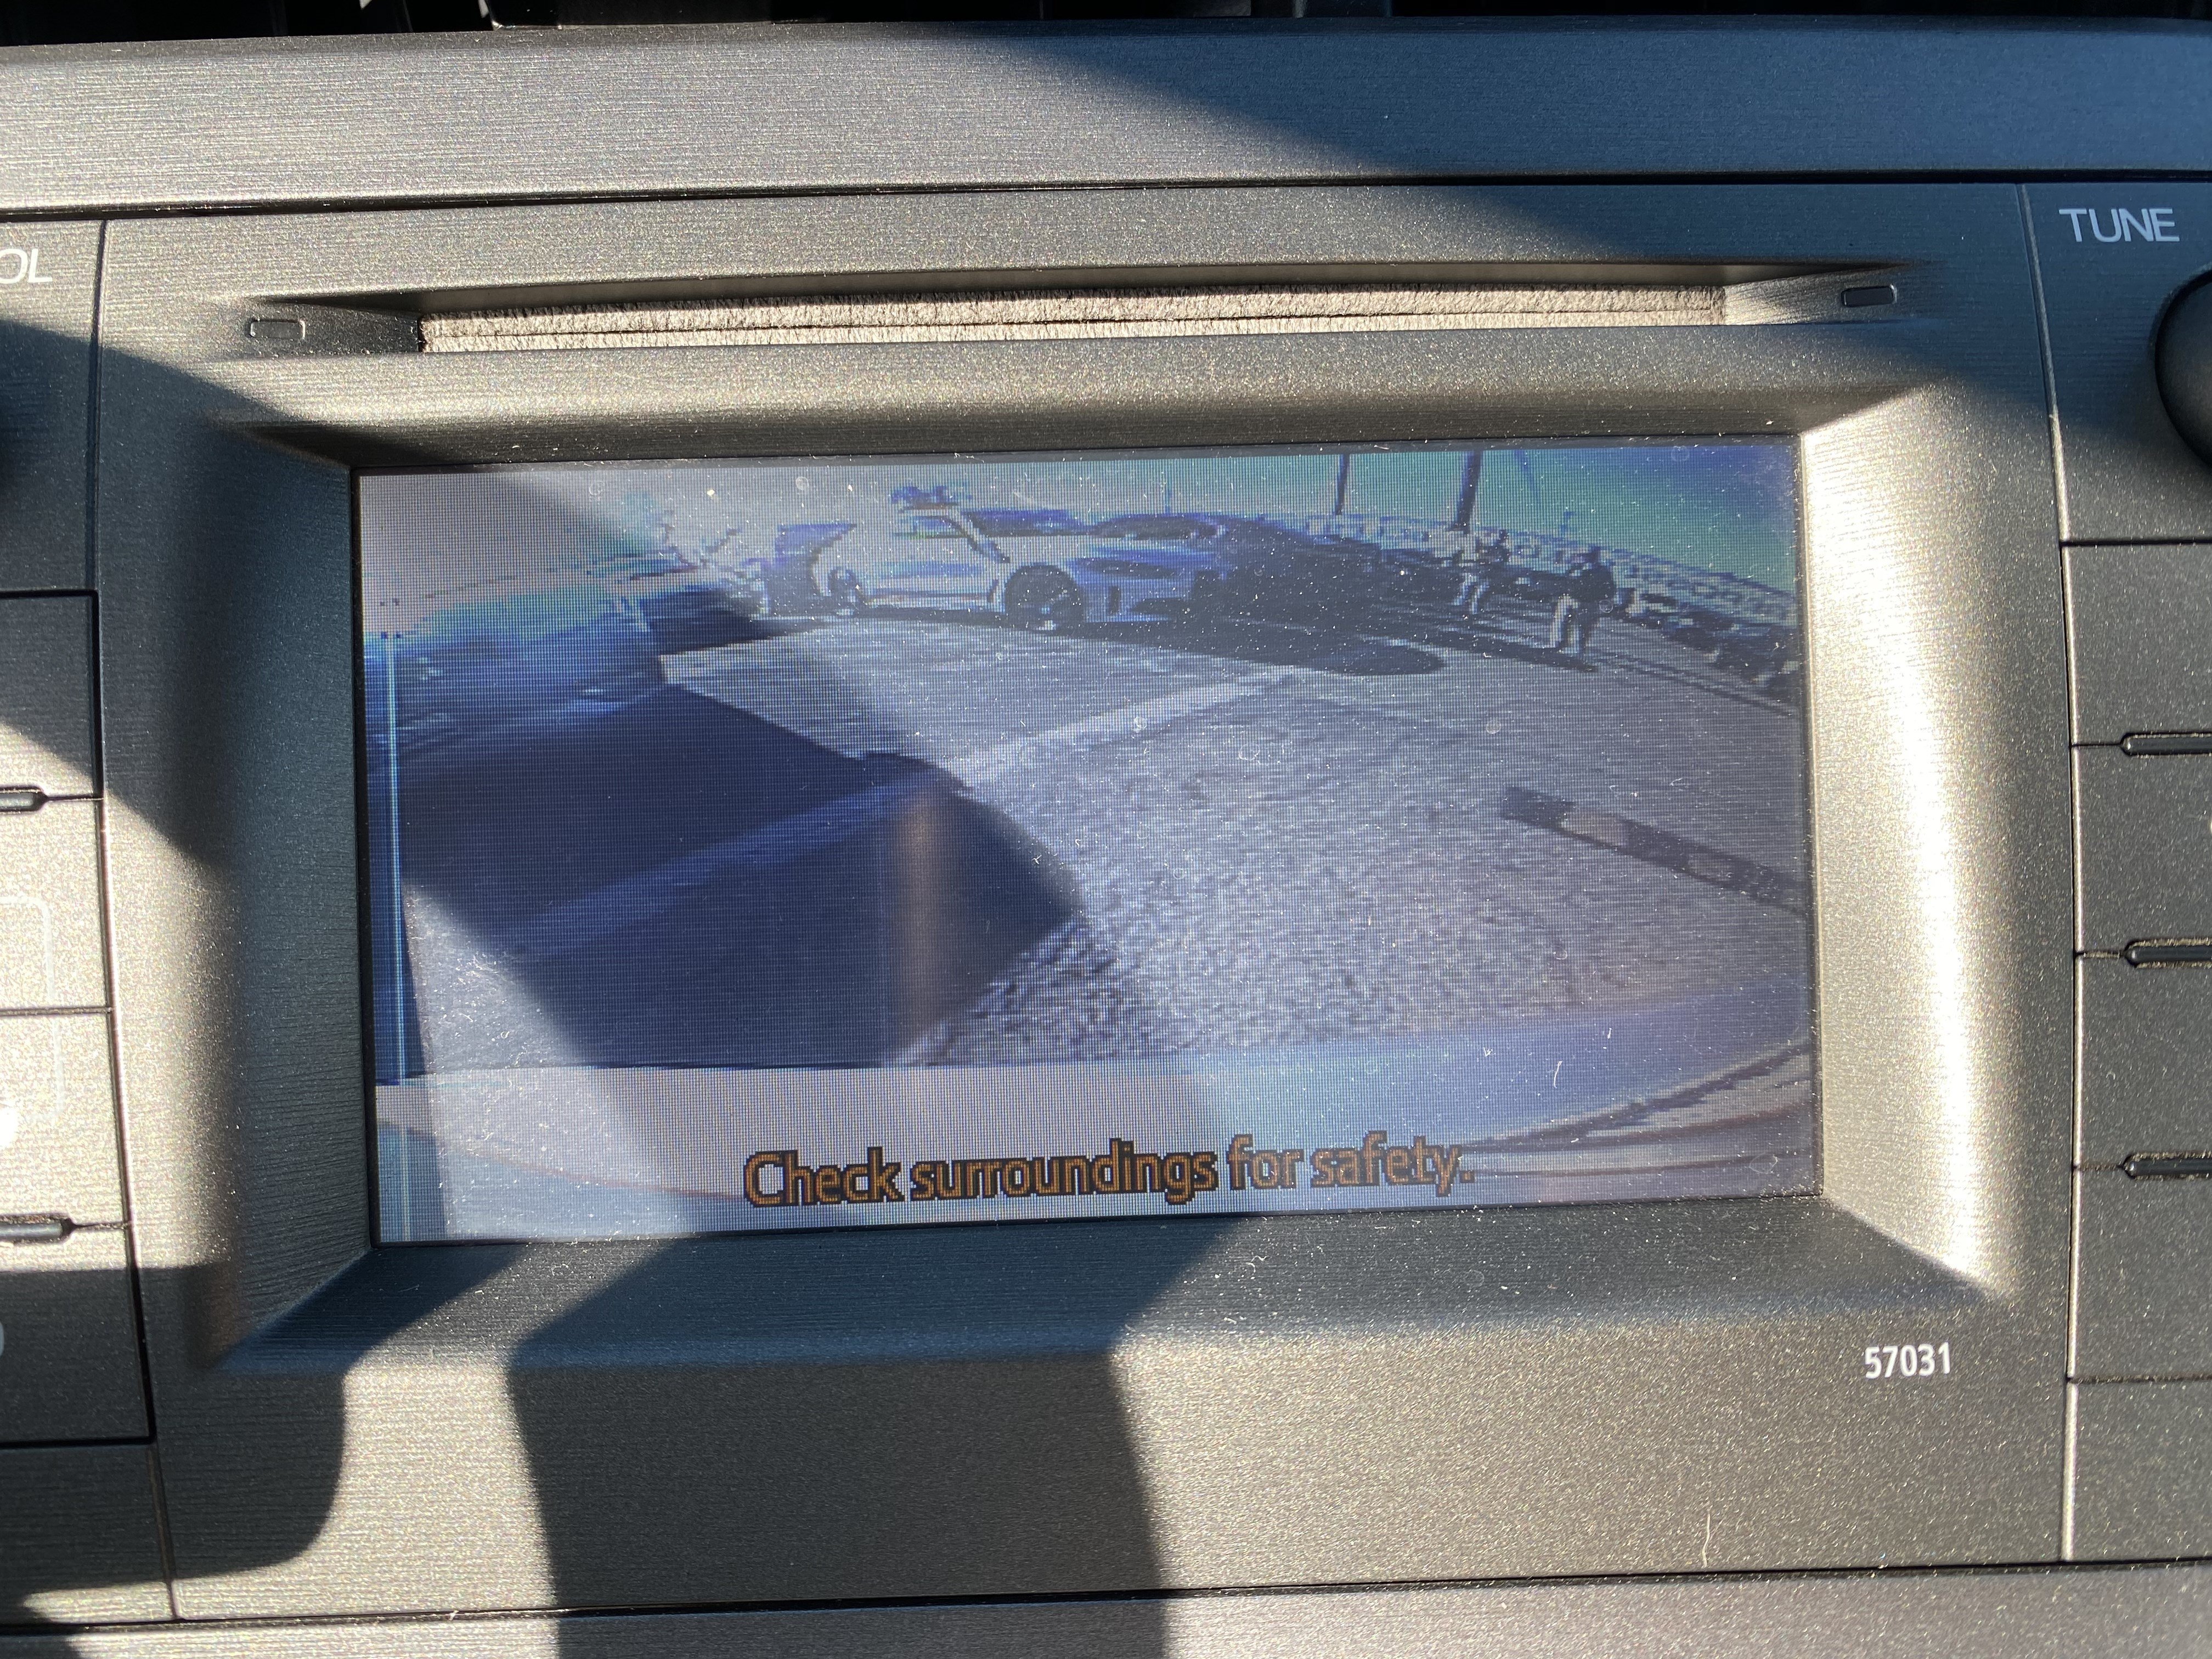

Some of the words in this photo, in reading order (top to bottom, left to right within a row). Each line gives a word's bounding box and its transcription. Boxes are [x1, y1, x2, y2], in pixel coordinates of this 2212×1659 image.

[2058, 208, 2180, 242] TUNE
[744, 1147, 904, 1207] Check
[910, 1137, 1217, 1205] surroundings
[1228, 1133, 1304, 1190] for
[1311, 1130, 1476, 1197] safety.
[1865, 1342, 1951, 1379] 57031
